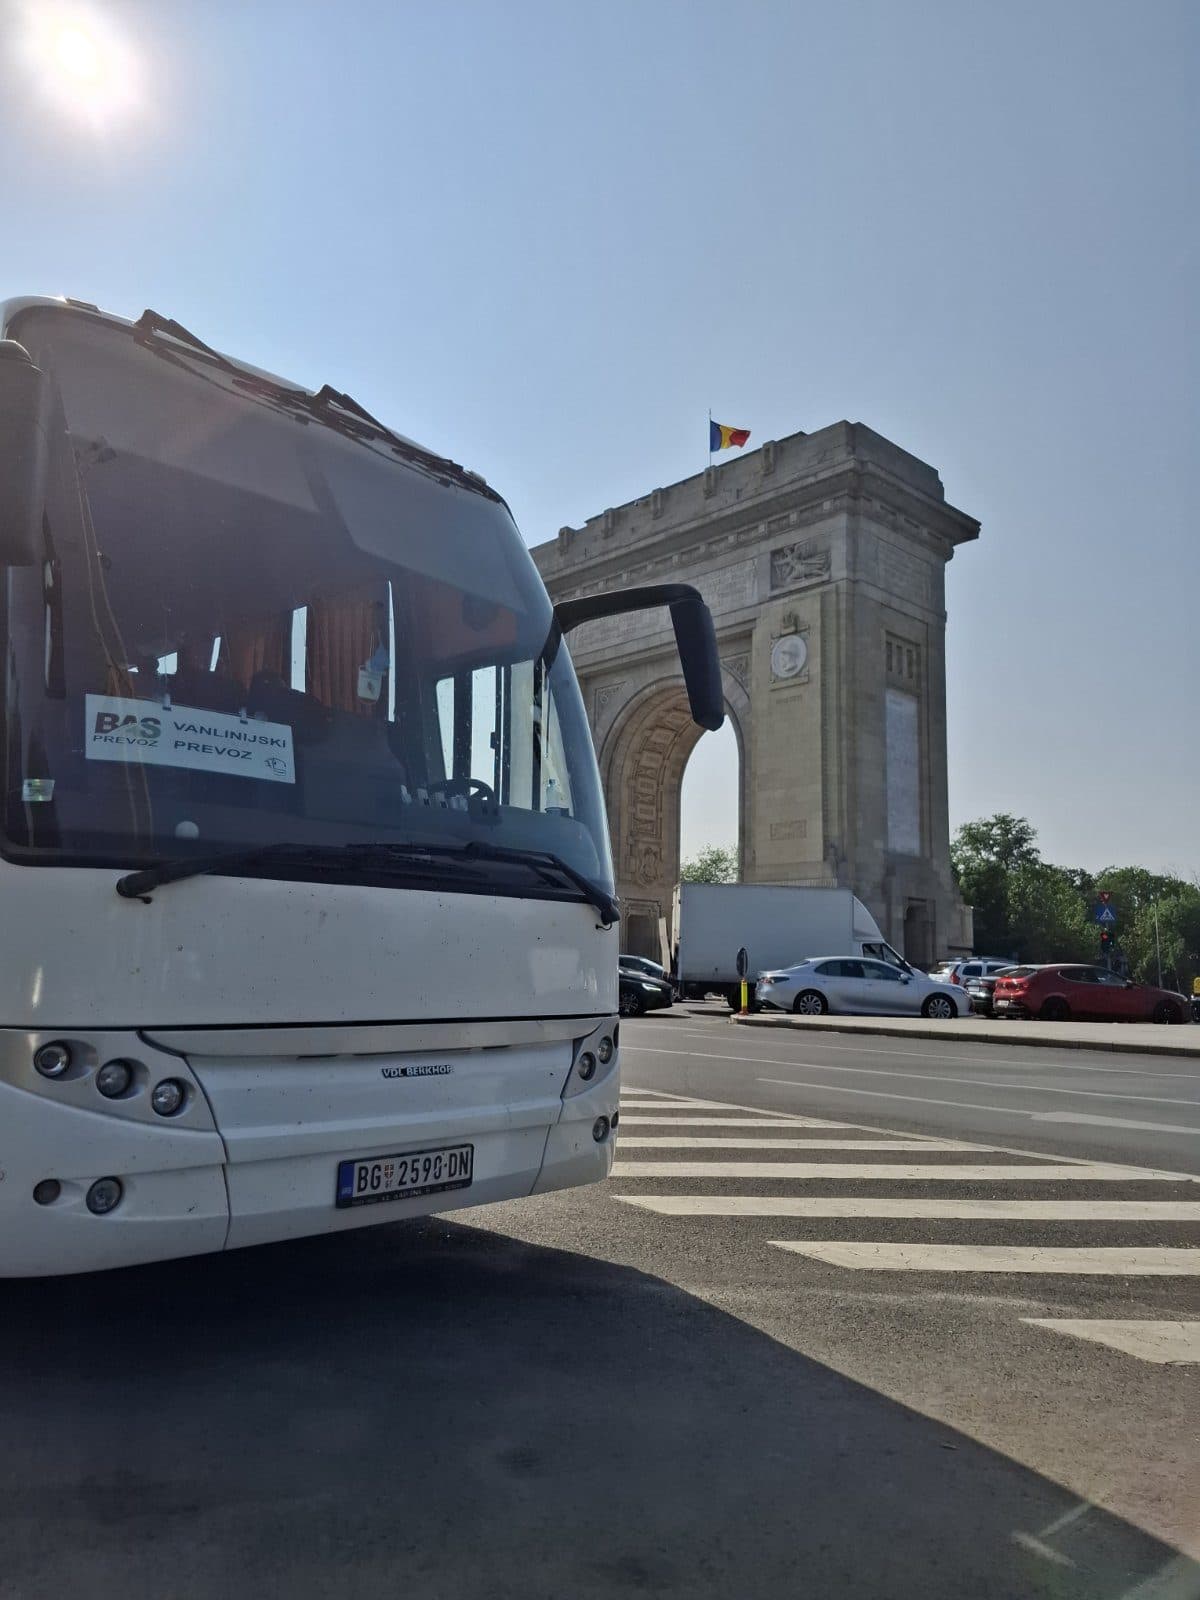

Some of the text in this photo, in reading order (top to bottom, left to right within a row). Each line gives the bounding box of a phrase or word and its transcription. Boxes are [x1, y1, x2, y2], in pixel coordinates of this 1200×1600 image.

[95, 712, 161, 739] BAS
[173, 721, 286, 748] VANLINIJSKI
[93, 735, 159, 748] PREVOZ
[174, 740, 252, 760] PREVOZ
[383, 1065, 453, 1078] VDL BERKHOF
[357, 1164, 381, 1192] BG
